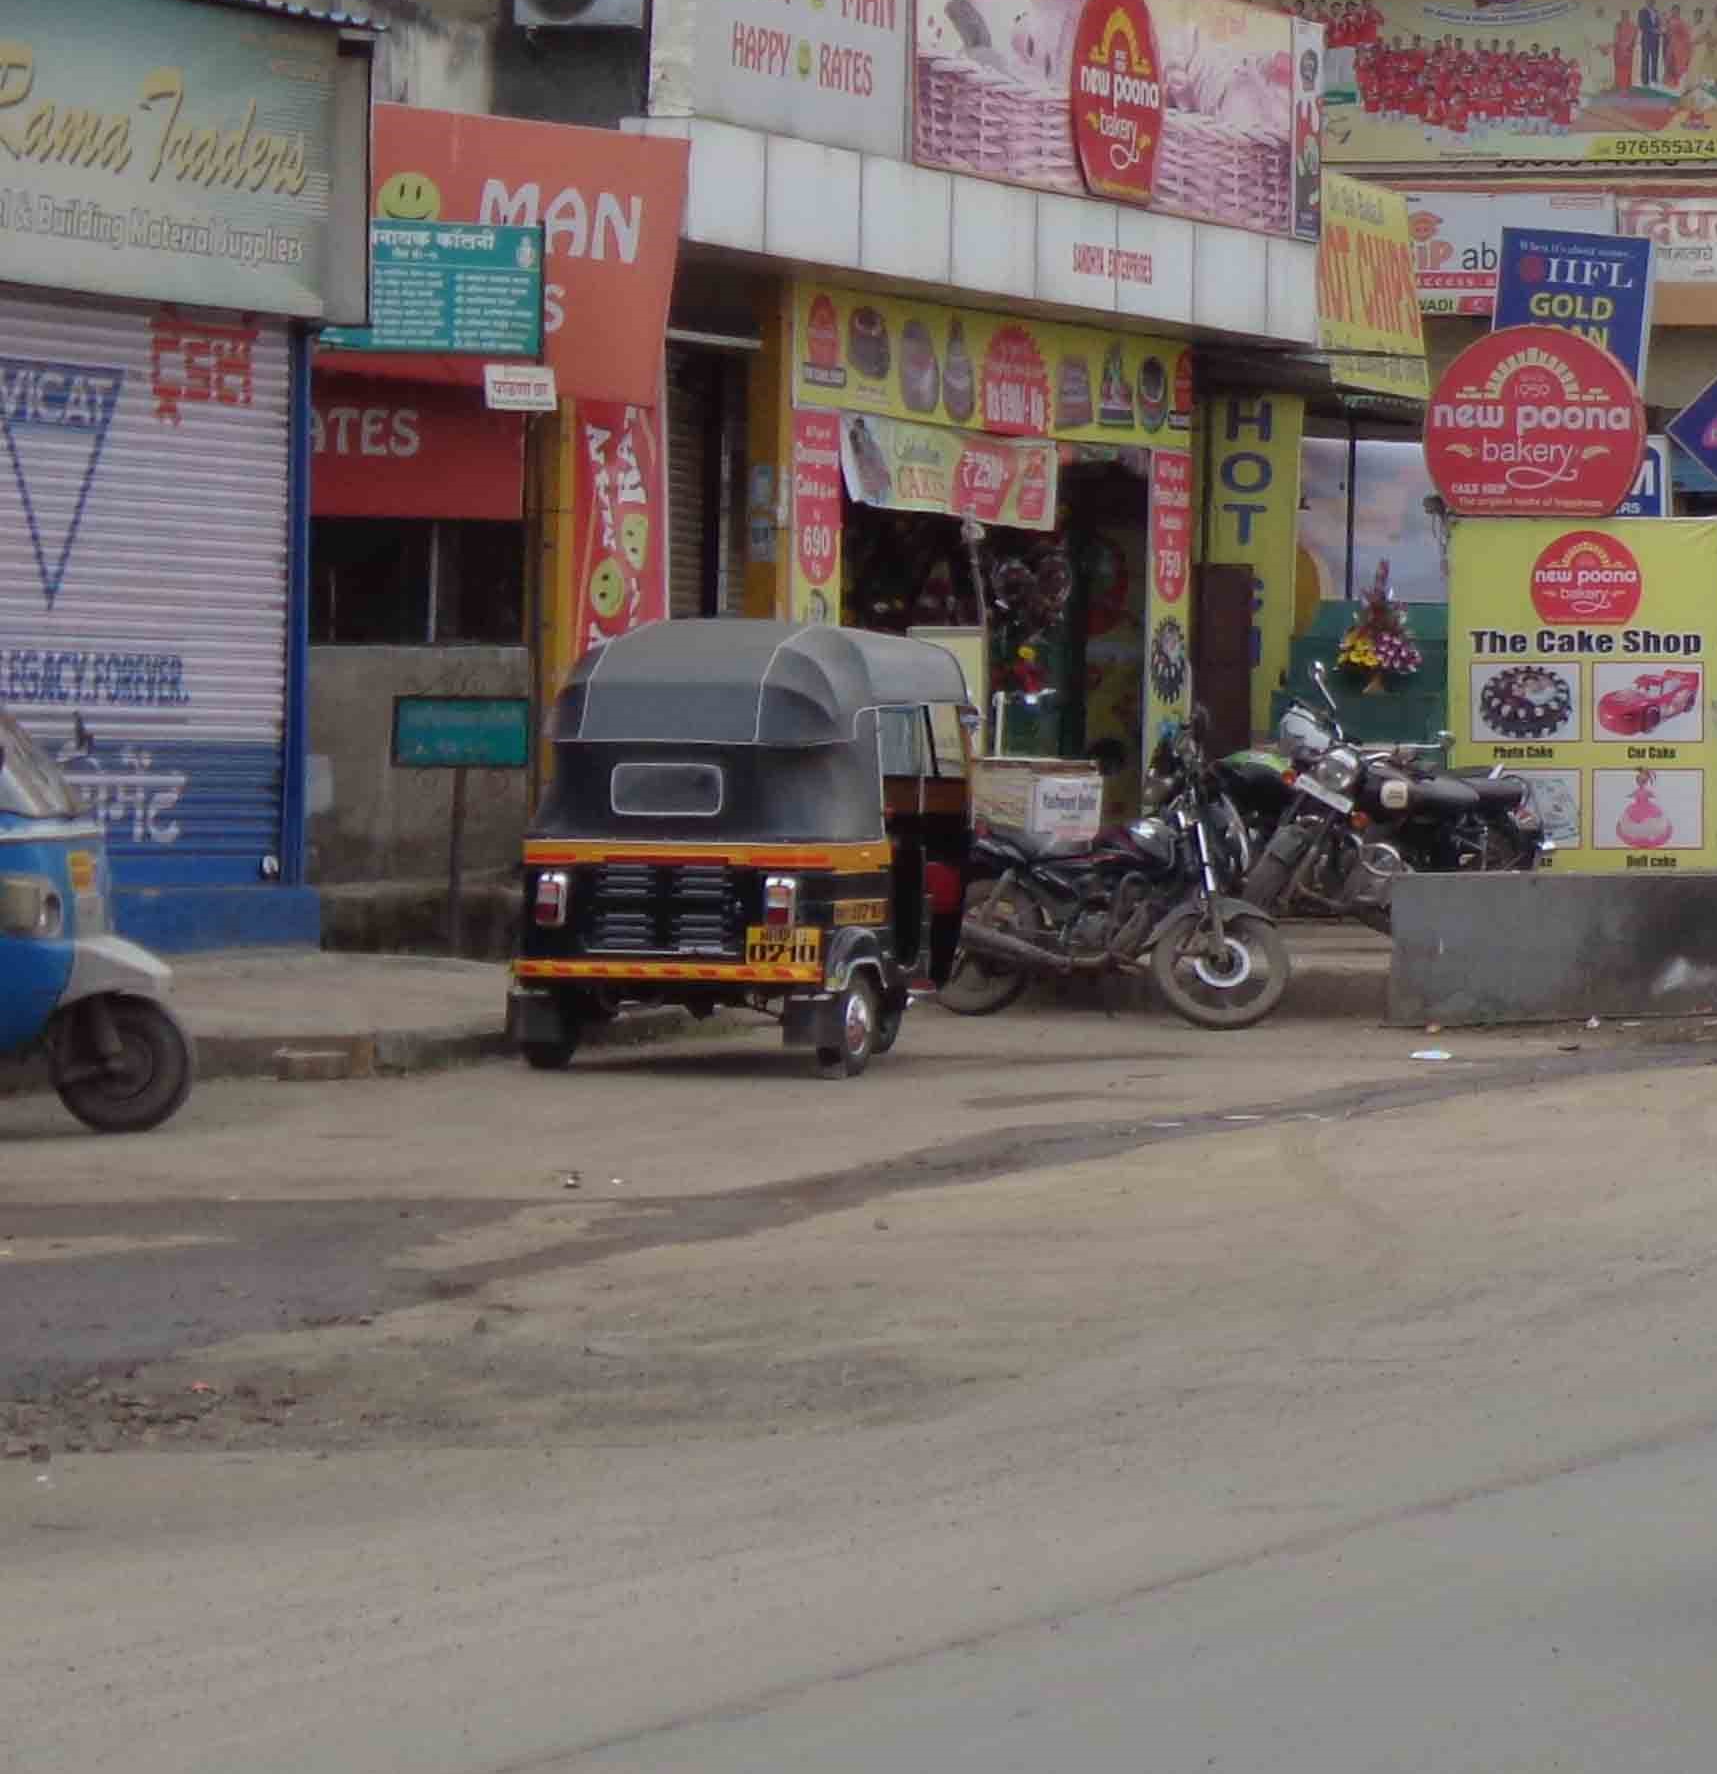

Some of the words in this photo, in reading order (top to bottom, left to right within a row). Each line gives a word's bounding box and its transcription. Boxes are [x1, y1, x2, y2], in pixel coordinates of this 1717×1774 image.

[732, 22, 791, 77] HAPPY
[818, 43, 873, 97] RATES
[139, 66, 306, 196] Traders
[37, 194, 127, 251] Building
[129, 208, 214, 256] Material
[221, 222, 305, 267] Suppliers
[479, 179, 641, 262] MAN
[1546, 258, 1633, 289] IIFL
[1530, 293, 1614, 321] GOLD
[1433, 404, 1504, 429] new
[1516, 404, 1632, 436] poona
[1219, 400, 1273, 547] HOT
[1482, 435, 1578, 484] bakery
[802, 526, 831, 560] 690
[1535, 570, 1572, 583] new
[1577, 569, 1637, 587] poona
[1470, 630, 1527, 654] The
[1536, 630, 1614, 654] Cake
[1622, 629, 1702, 656] Shop
[1526, 746, 1554, 759] Cake
[1626, 746, 1647, 759] Car
[1648, 746, 1677, 759] Cake
